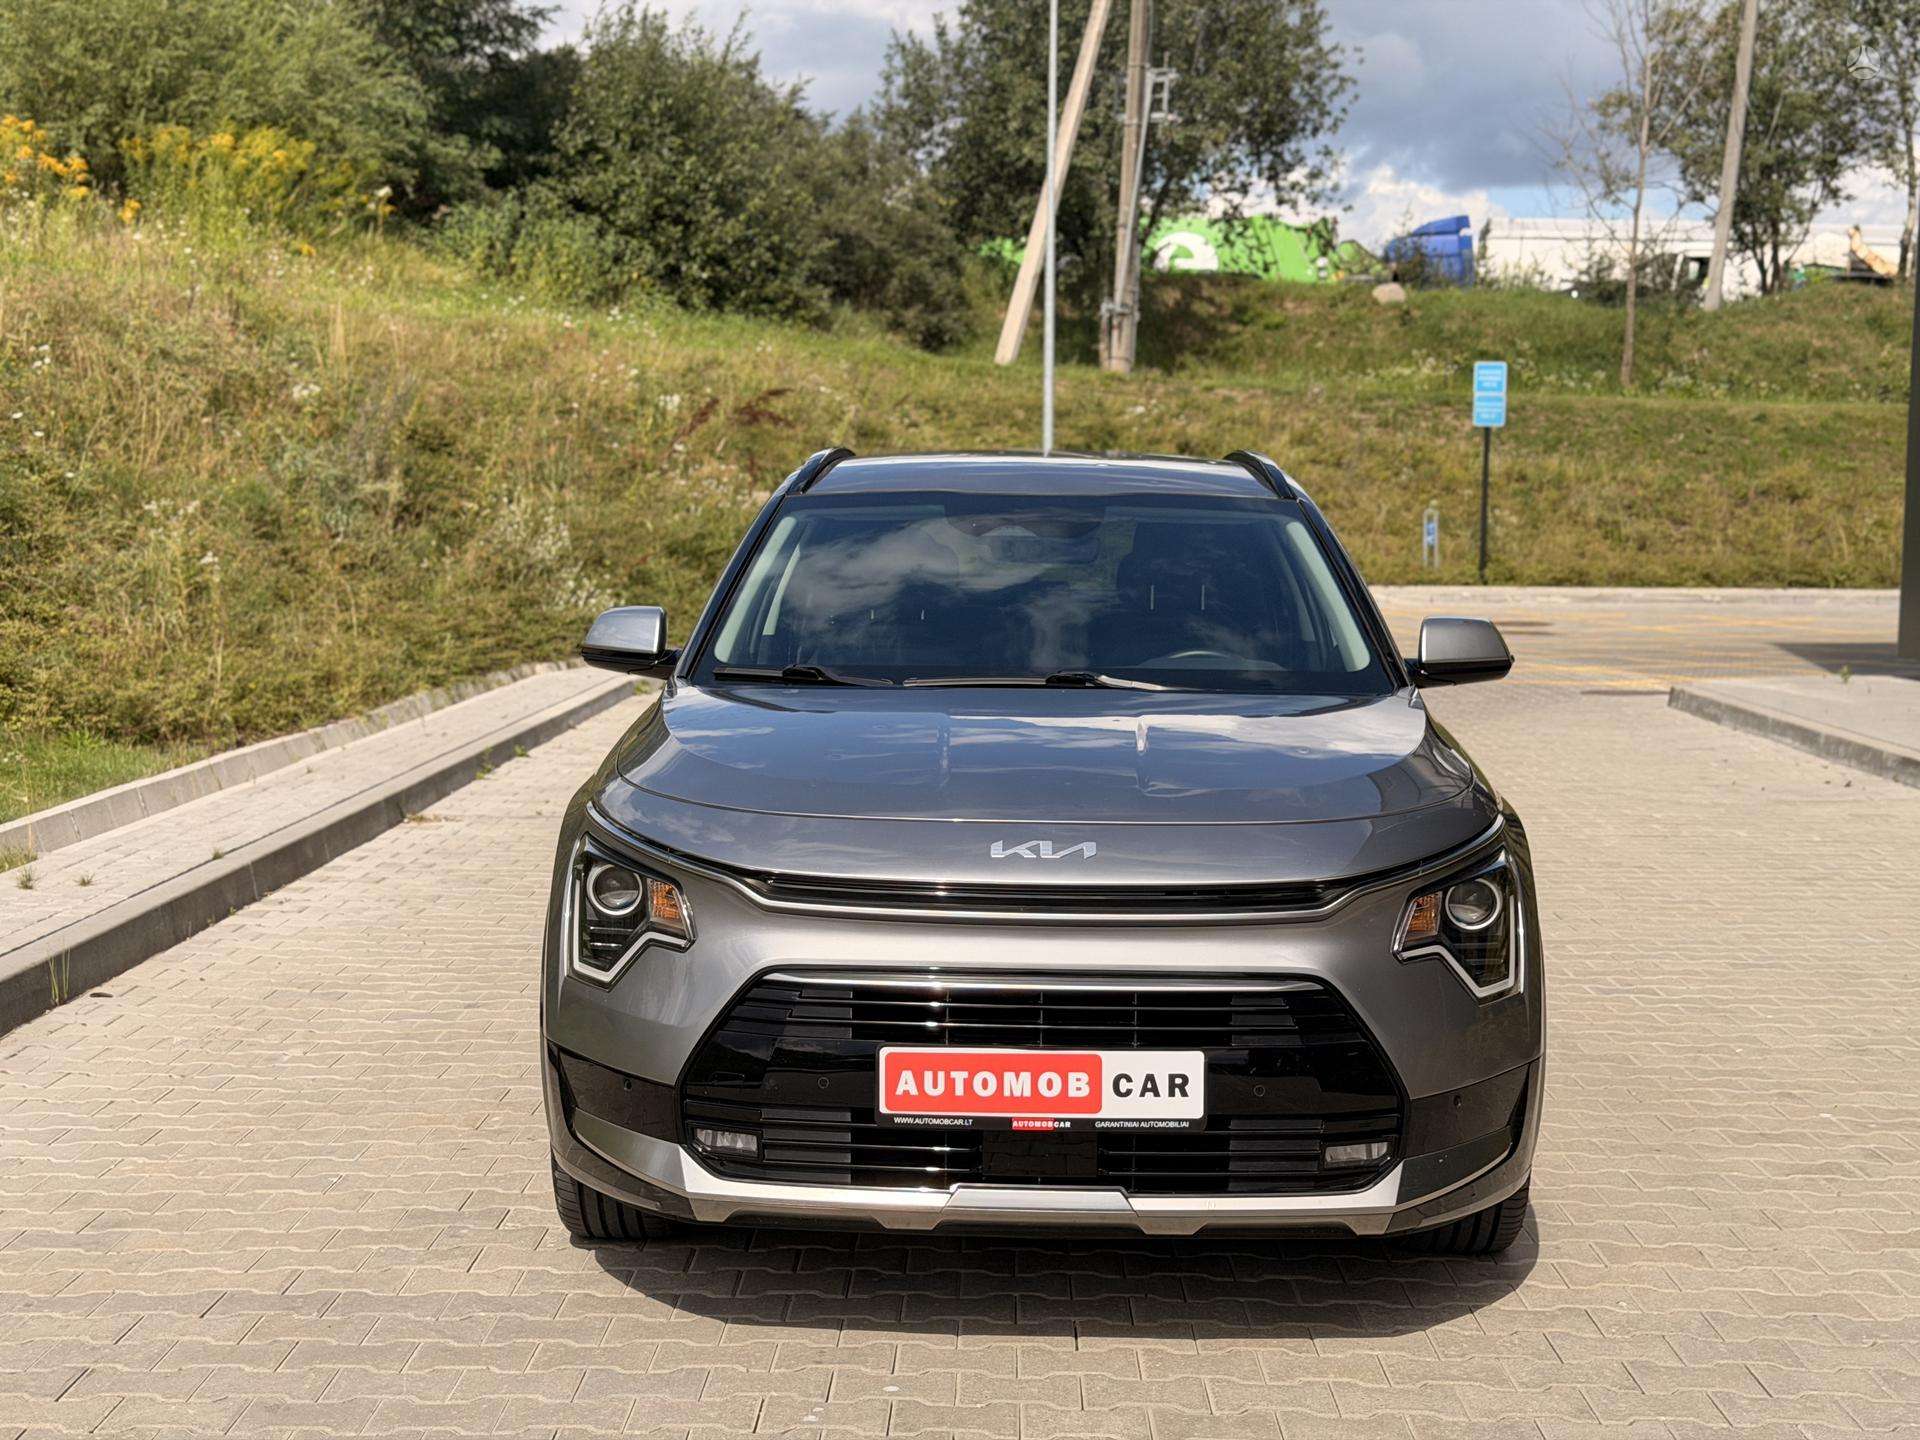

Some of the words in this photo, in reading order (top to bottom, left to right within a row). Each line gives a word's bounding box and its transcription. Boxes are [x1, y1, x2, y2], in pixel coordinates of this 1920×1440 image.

[990, 839, 1097, 859] KIA
[895, 1069, 1091, 1098] AUTOMOB
[1112, 1073, 1190, 1098] CAR
[893, 1116, 974, 1126] WWW.AUTOMOBCAR.LT
[1094, 1120, 1139, 1128] GARANTINIAI
[1140, 1120, 1190, 1128] AUTOMOBILIAI
